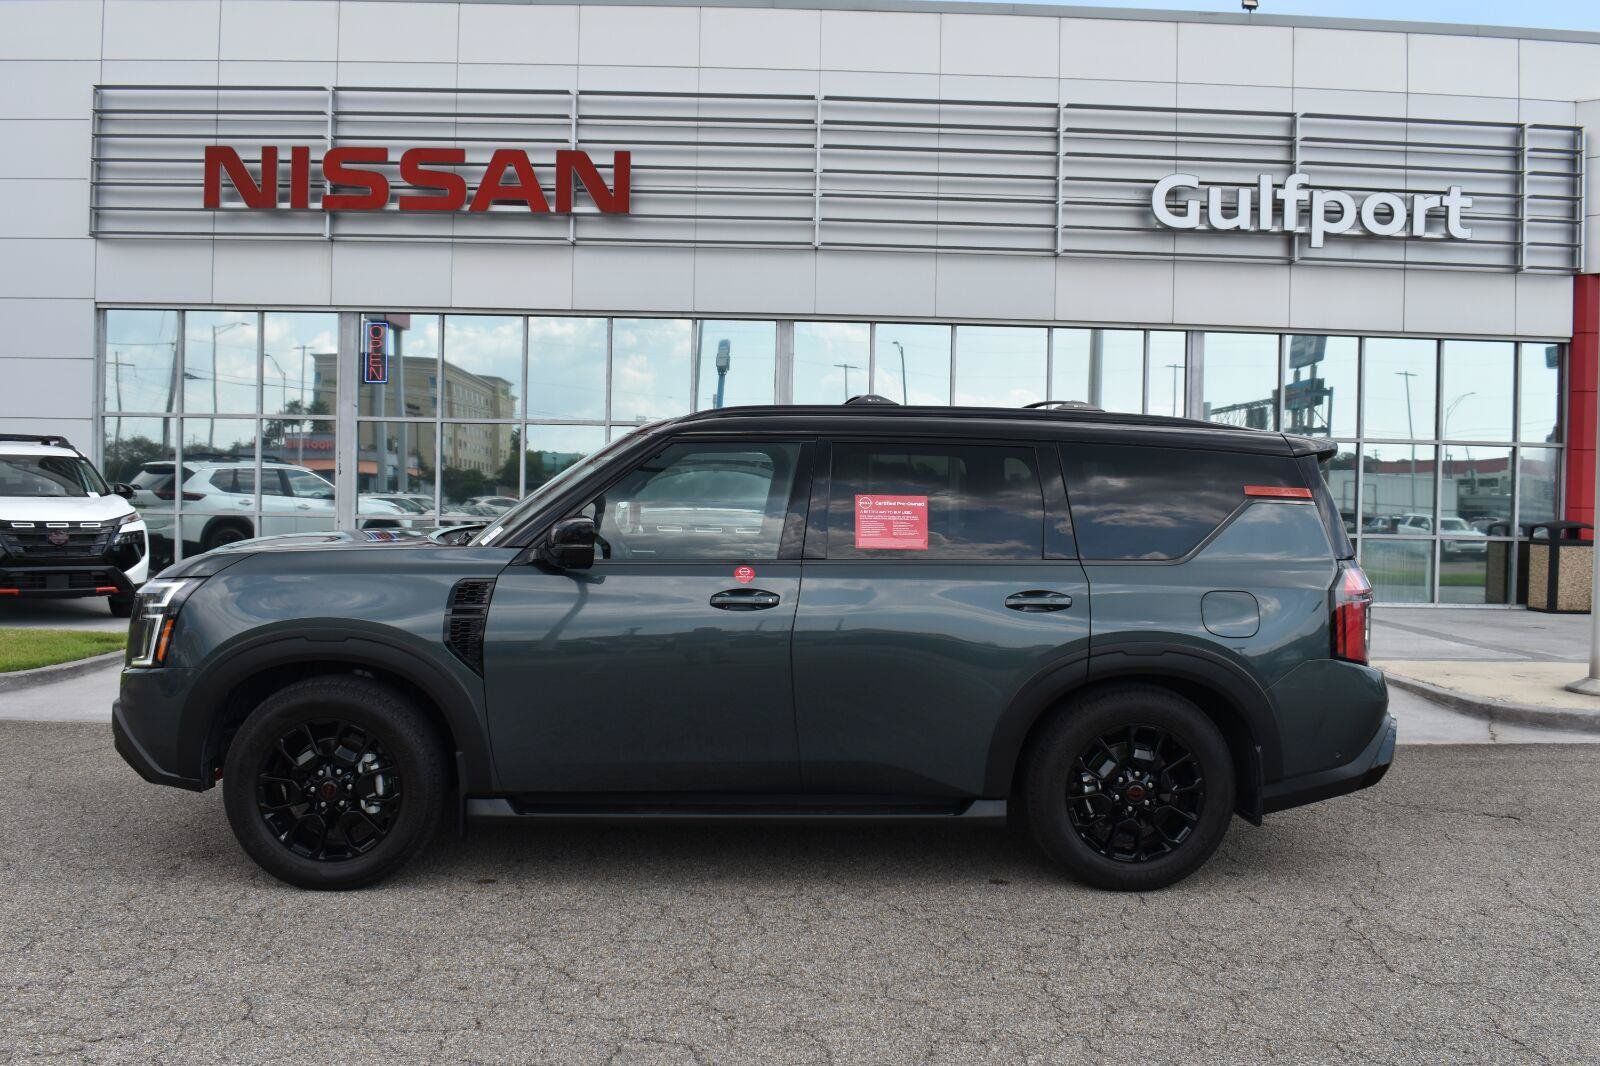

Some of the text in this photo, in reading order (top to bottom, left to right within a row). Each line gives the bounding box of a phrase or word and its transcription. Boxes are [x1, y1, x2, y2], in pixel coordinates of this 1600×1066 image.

[203, 145, 631, 215] NISSAN
[1151, 173, 1473, 248] Gulfport
[369, 325, 384, 381] OPEN
